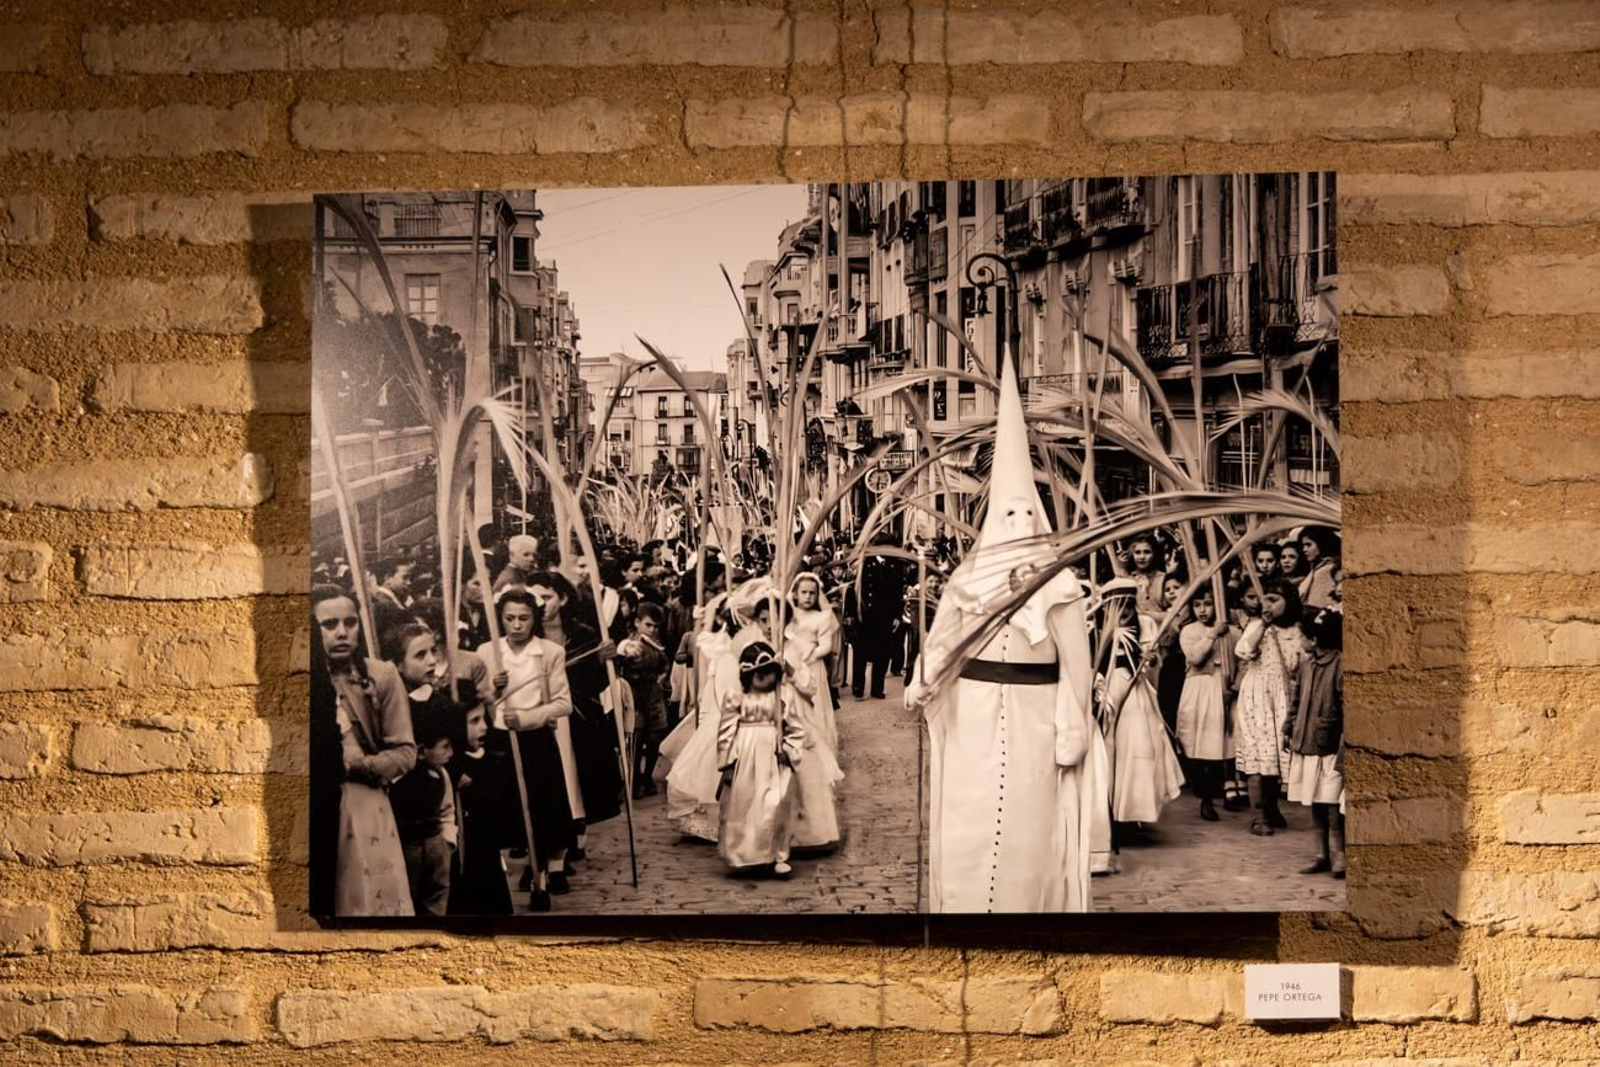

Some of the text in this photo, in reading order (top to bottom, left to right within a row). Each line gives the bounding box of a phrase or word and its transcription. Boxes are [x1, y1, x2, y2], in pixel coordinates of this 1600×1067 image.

[1280, 982, 1301, 990] 1946
[1258, 992, 1322, 1001] PEPE ORTEGA
